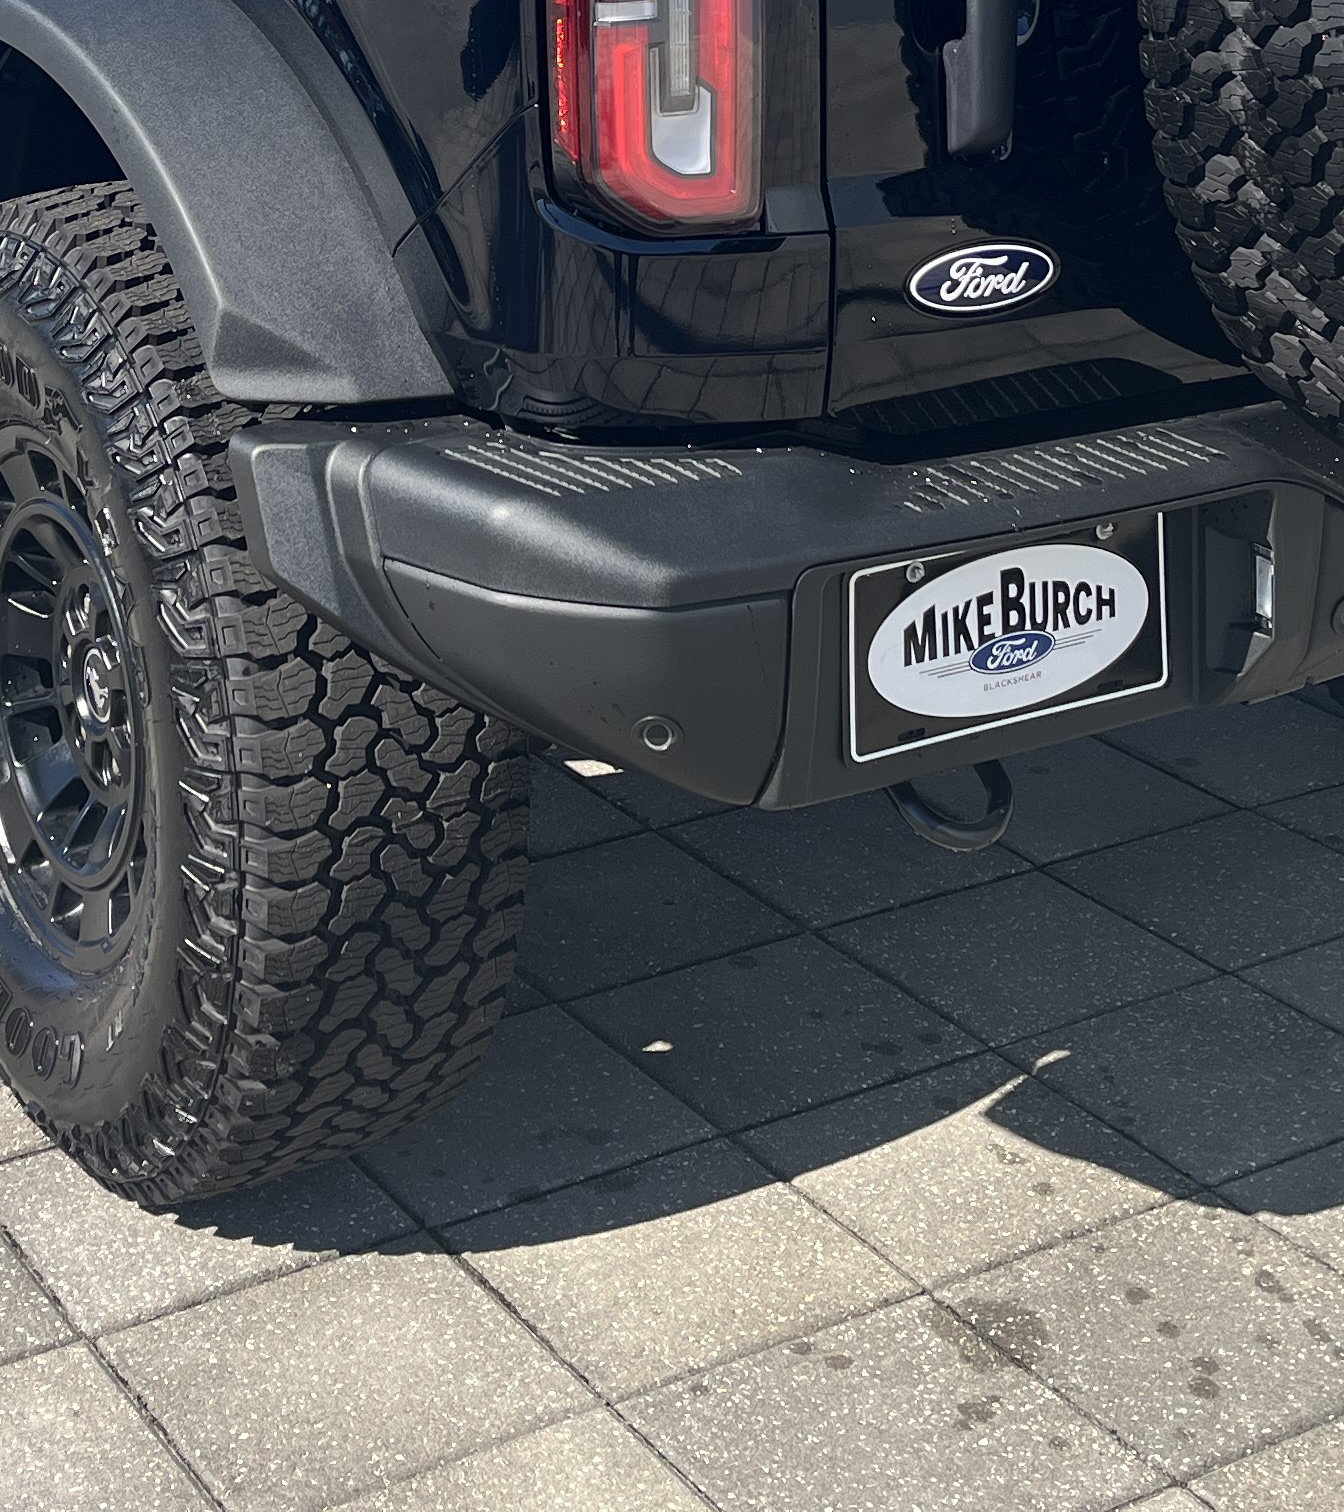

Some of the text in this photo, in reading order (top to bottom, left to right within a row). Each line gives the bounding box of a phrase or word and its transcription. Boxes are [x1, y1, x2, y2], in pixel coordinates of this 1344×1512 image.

[940, 255, 1030, 302] Ford
[903, 567, 1116, 667] MIKE BURCH
[987, 637, 1039, 670] Ford
[983, 670, 1042, 692] BLACKSHEAR
